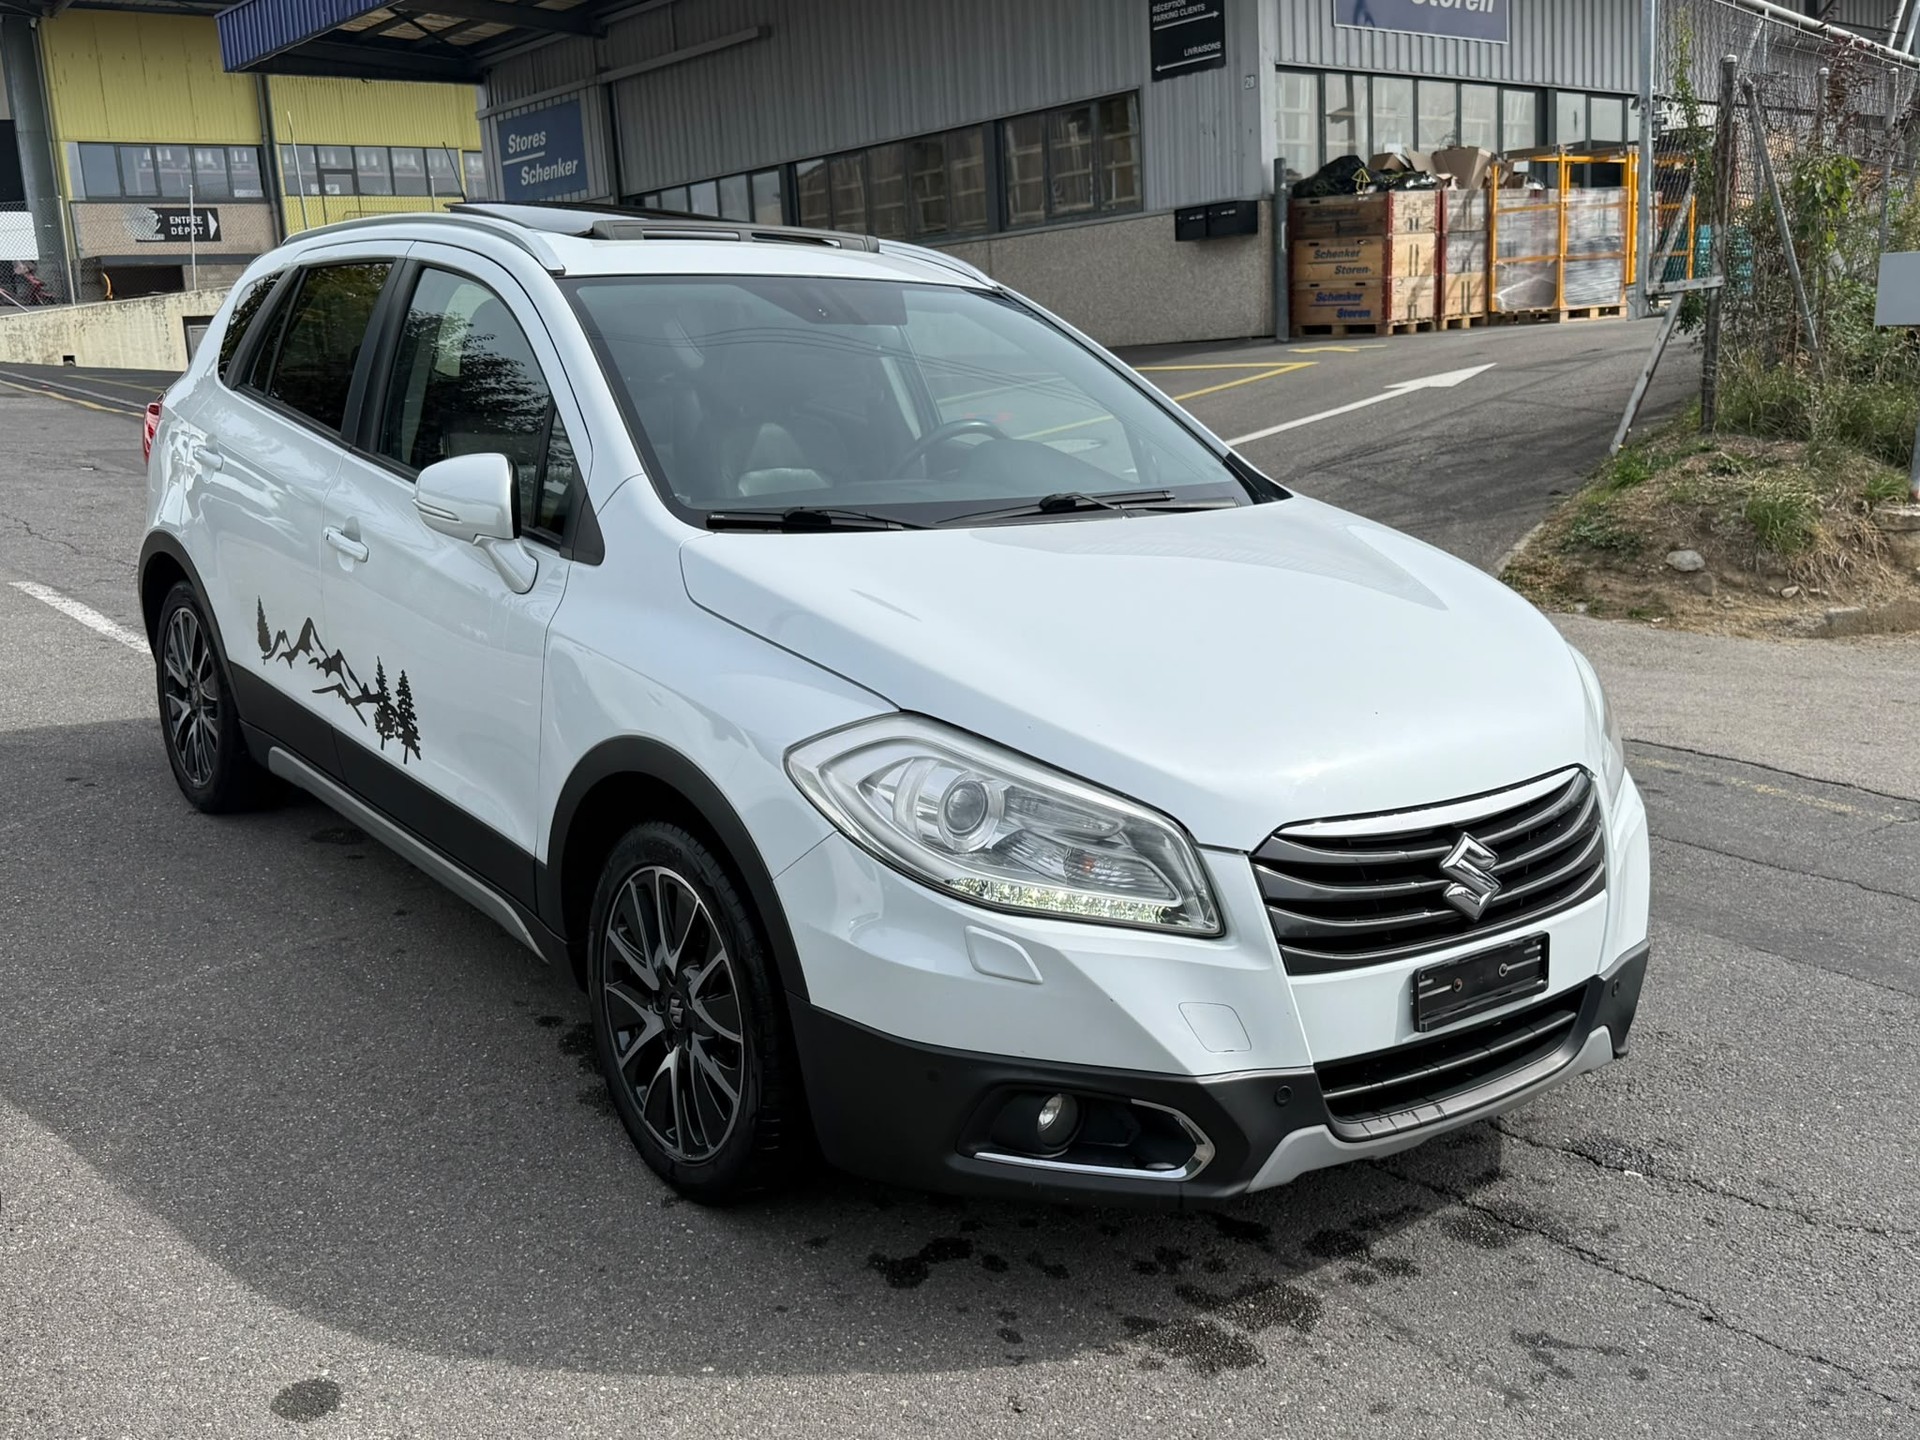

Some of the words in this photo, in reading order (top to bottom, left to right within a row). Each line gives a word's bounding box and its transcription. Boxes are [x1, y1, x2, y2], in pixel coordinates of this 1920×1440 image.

[1153, 11, 1179, 22] PARKING
[1179, 3, 1206, 16] CLIENTS
[1184, 42, 1221, 56] LIVRAISONS
[508, 130, 546, 154] Stores
[521, 158, 578, 185] Schenker
[1314, 248, 1360, 259] Schenker
[1316, 292, 1363, 302] Schenker
[1336, 308, 1371, 318] Storen
